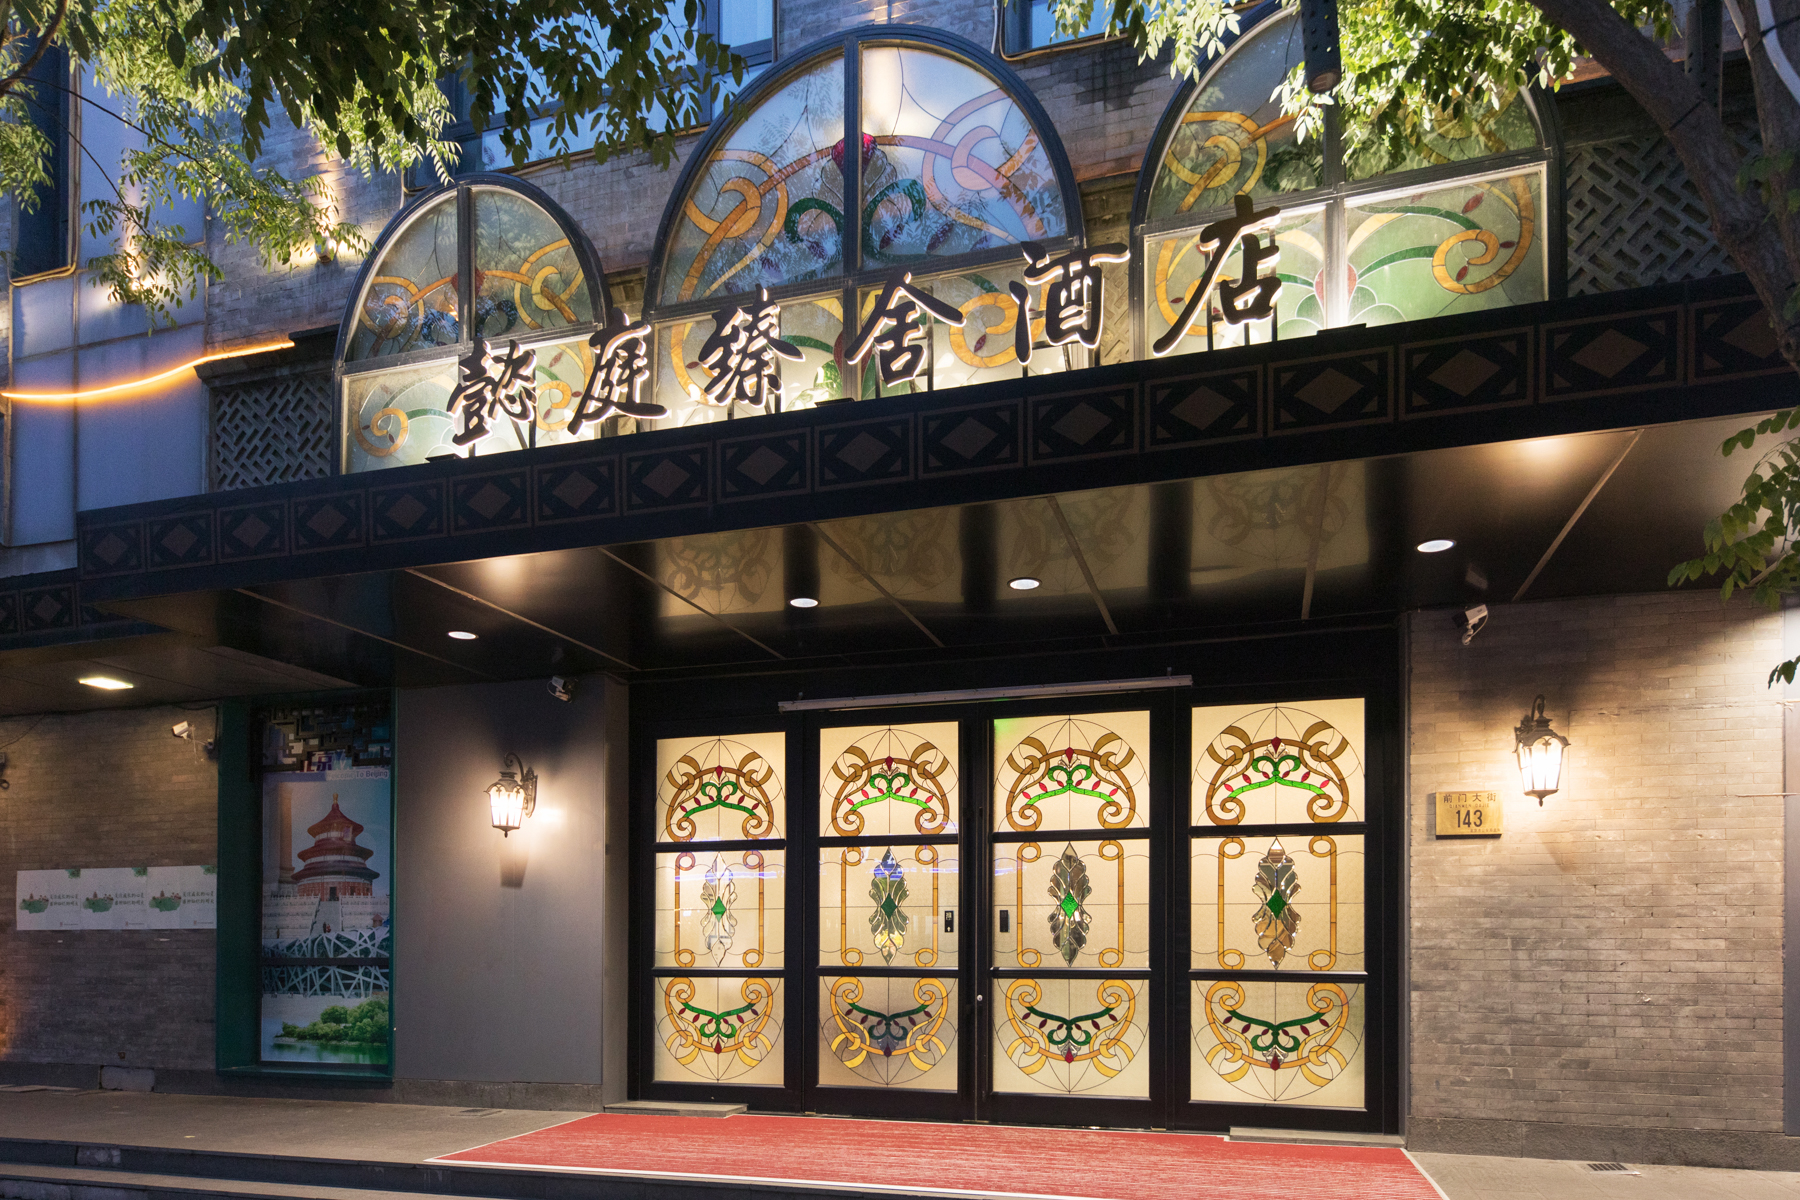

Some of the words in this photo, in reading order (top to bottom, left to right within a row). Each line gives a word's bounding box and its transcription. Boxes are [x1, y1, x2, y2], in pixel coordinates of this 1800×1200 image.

[446, 194, 1282, 447] 懿庭臻舍酒店
[365, 769, 388, 778] Beijing
[1443, 793, 1496, 803] 前门大街
[1456, 809, 1483, 828] 143
